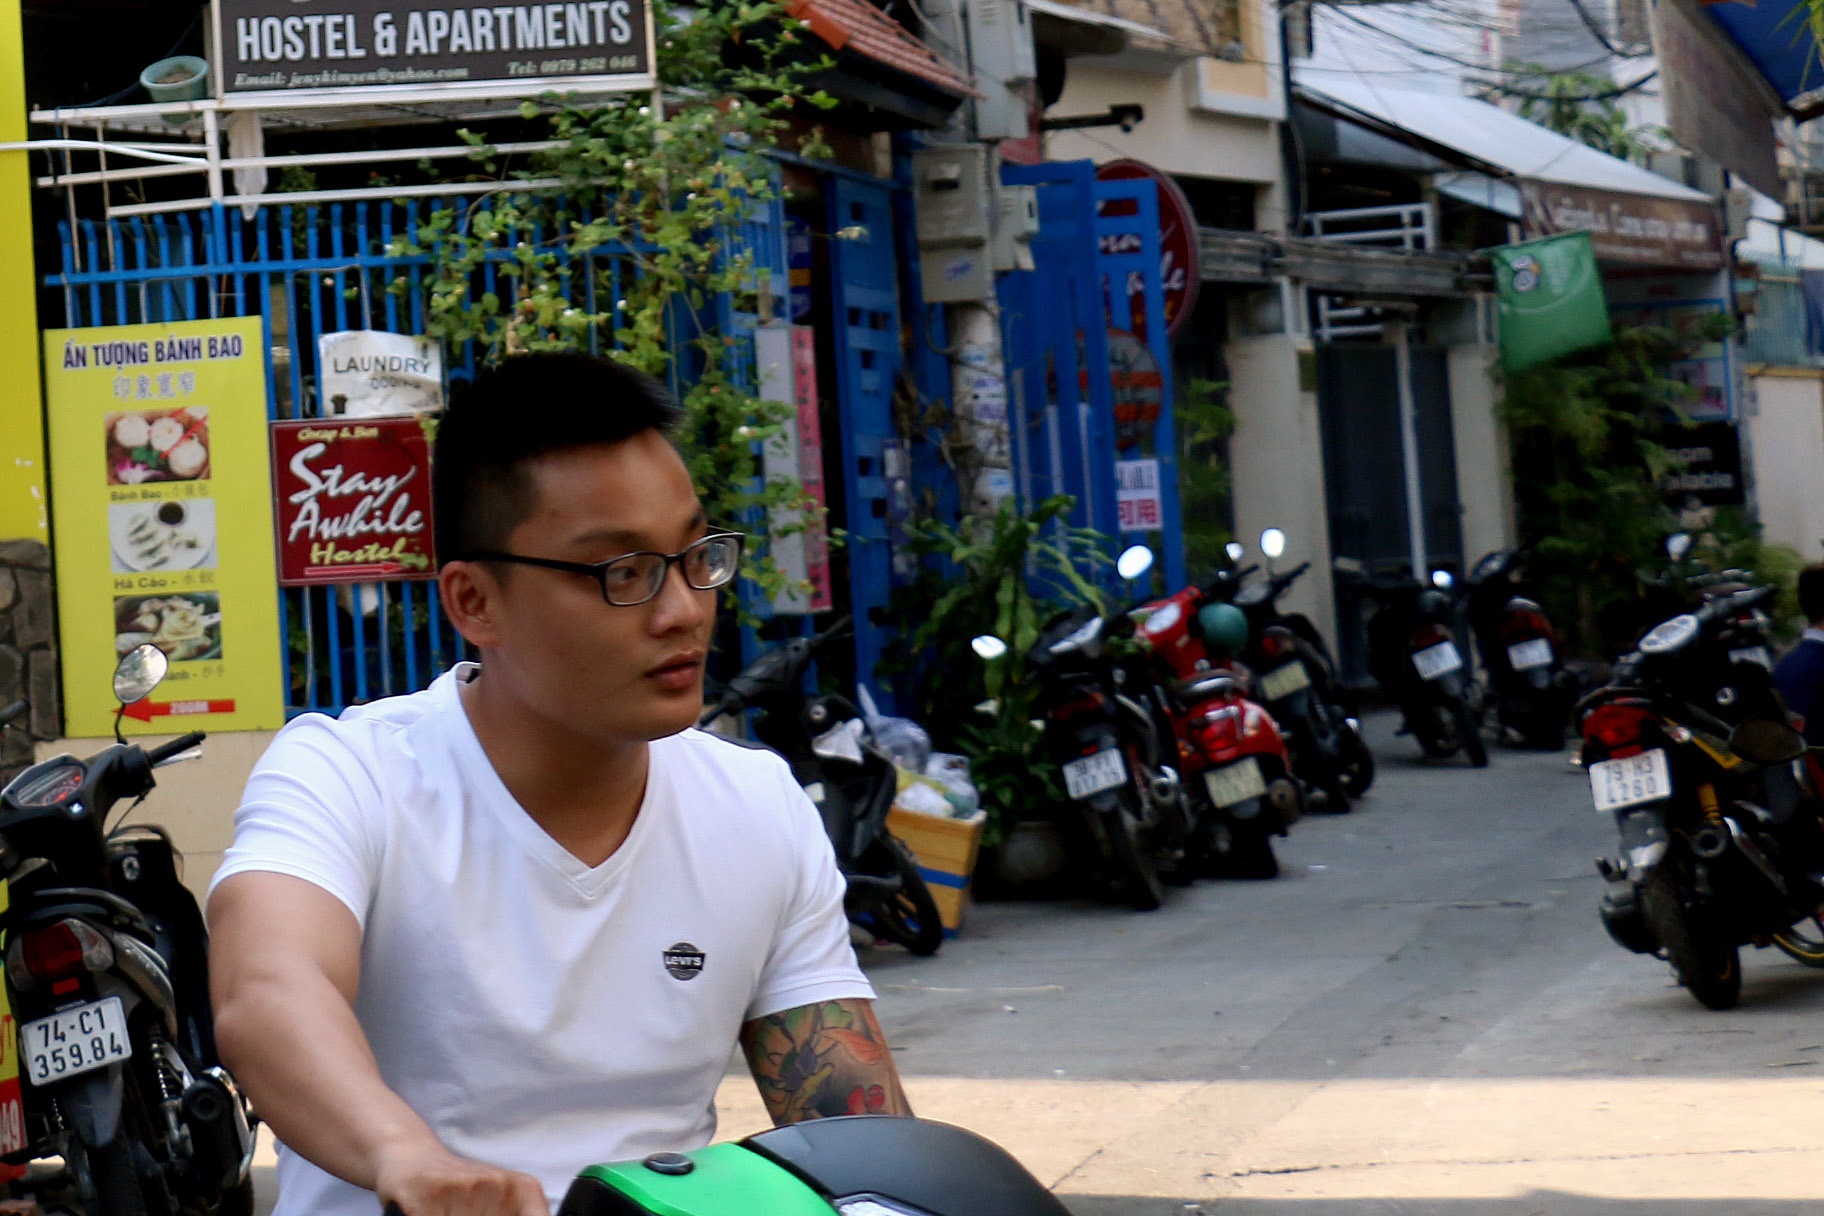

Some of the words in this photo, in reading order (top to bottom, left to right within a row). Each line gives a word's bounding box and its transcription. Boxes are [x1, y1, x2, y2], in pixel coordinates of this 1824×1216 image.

[235, 11, 366, 63] HOSTEL
[373, 11, 398, 58] &
[208, 334, 243, 359] BAO
[333, 354, 433, 375] LAUNDRY
[288, 441, 418, 507] Stay
[288, 491, 425, 545] Awhile
[310, 537, 409, 567] Hostel
[37, 1006, 106, 1048] 74-C1
[34, 1032, 124, 1080] 359.84
